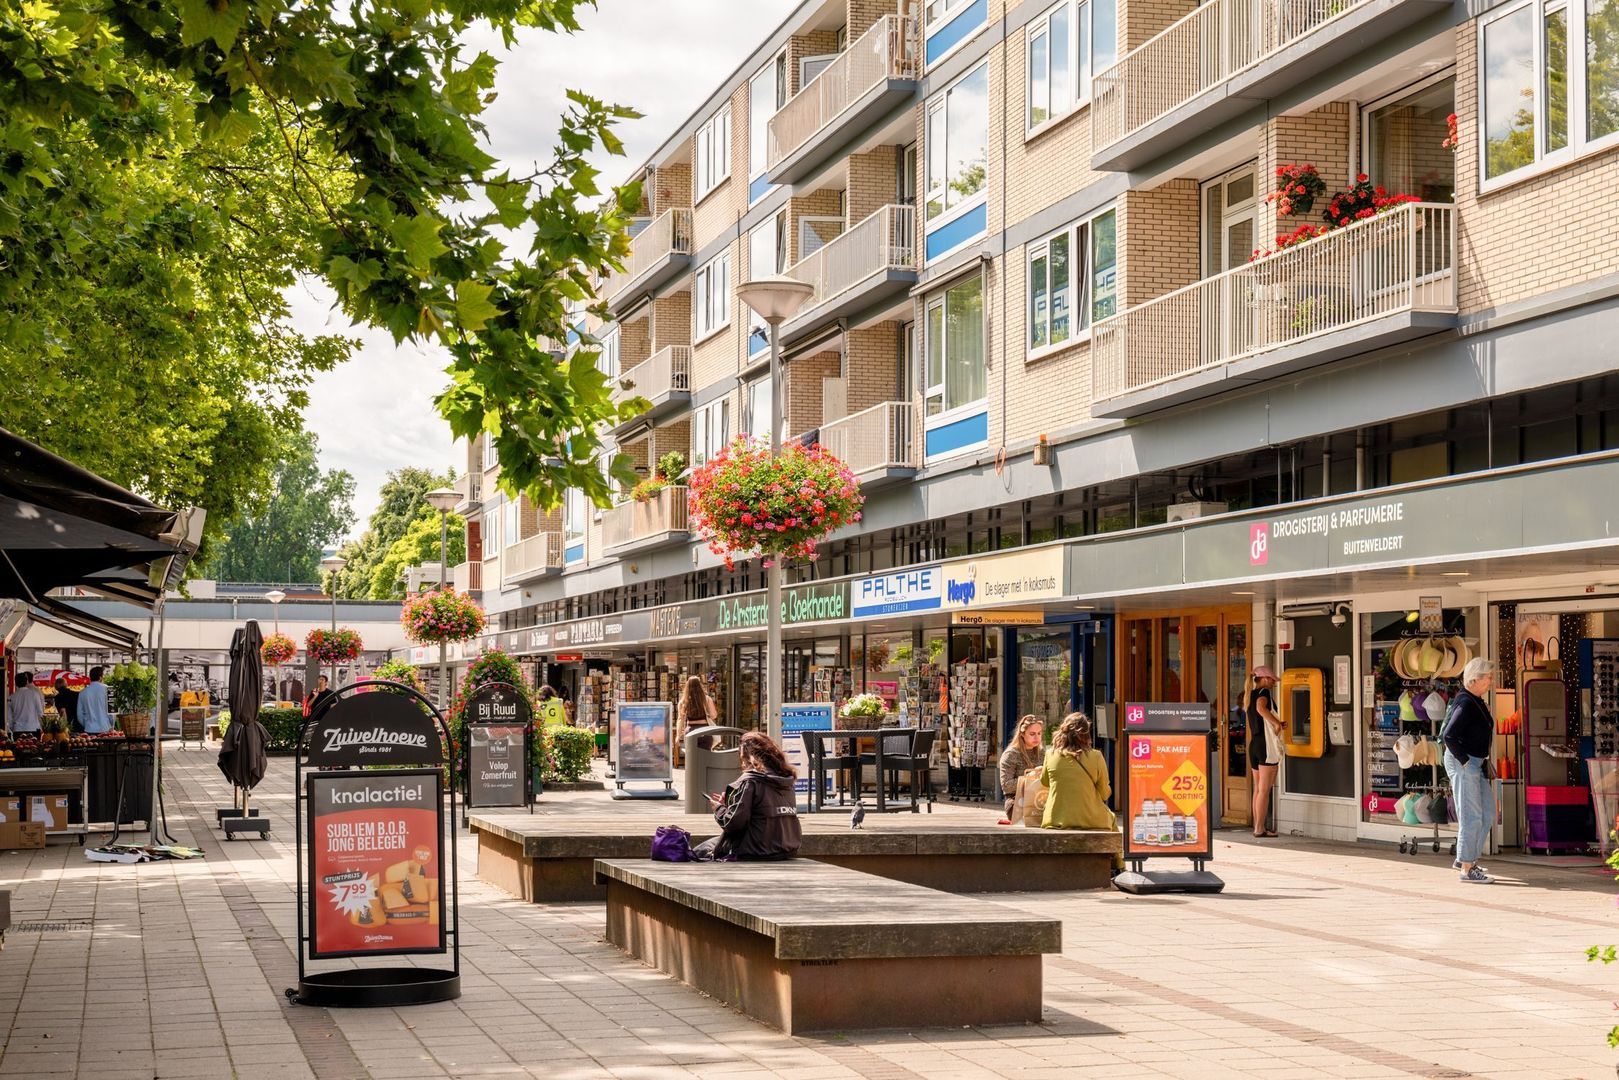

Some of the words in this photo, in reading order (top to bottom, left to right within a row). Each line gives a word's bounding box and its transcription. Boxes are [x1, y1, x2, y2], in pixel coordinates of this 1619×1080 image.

[1273, 514, 1329, 538] DROGISTERIJ
[1331, 512, 1338, 529] &
[1340, 502, 1403, 528] PARFUMERIE
[1251, 529, 1267, 560] da
[1343, 535, 1403, 555] BUITENVELDERT
[862, 570, 932, 599] PALTHE
[985, 581, 993, 596] De
[994, 580, 1010, 598] slager
[1011, 579, 1022, 593] met
[1029, 575, 1056, 591] koksmuts
[719, 600, 731, 629] De
[789, 583, 845, 621] Boekhandel
[478, 703, 490, 717] Bij
[493, 702, 516, 715] Ruud
[1128, 708, 1143, 722] da
[322, 727, 428, 753] Zuivelhoeve
[1132, 741, 1150, 758] da
[489, 761, 509, 770] Volop
[480, 770, 517, 780] Zomerfruit
[1172, 775, 1204, 791] 25%
[331, 784, 422, 804] knalactie!
[326, 822, 375, 838] SUBLIEM
[378, 820, 409, 836] B.O.B.
[327, 837, 355, 852] JONG
[357, 834, 406, 852] BELEGEN
[324, 872, 361, 883] STUNTPRIJS
